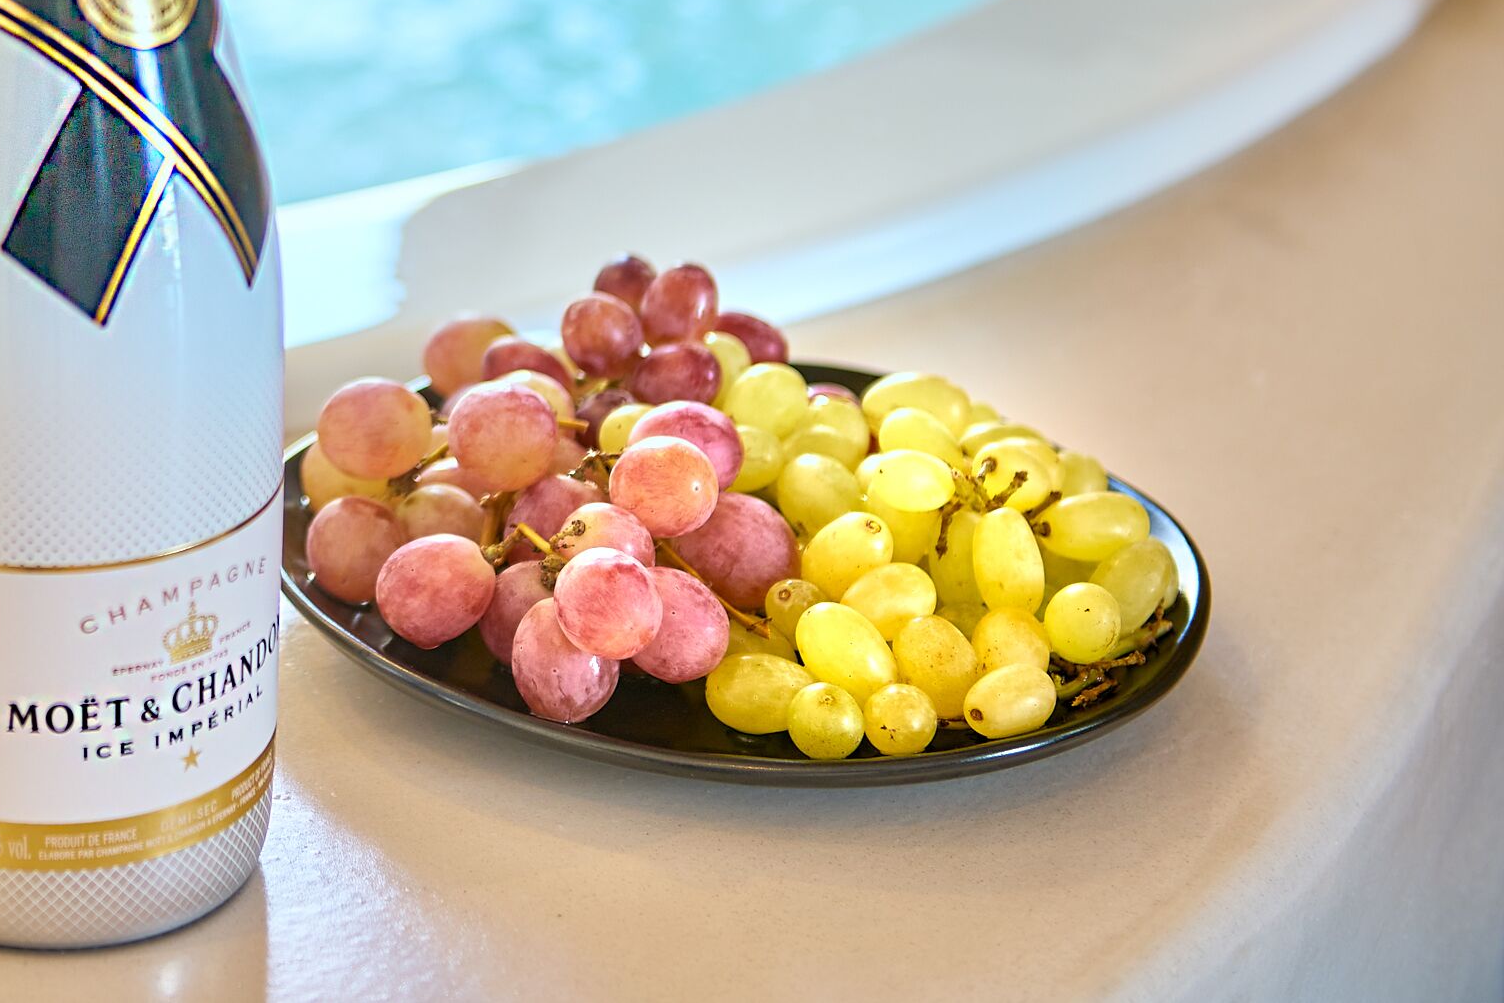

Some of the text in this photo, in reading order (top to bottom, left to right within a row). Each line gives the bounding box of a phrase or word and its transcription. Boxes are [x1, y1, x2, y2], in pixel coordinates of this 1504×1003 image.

[79, 556, 268, 635] CHAMPAGNE
[6, 613, 280, 734] MOËT & CHANDO
[83, 684, 264, 762] ICE IMPÉRIAL
[8, 834, 32, 860] vol.
[45, 828, 138, 848] PRODUIT DE FRANCE
